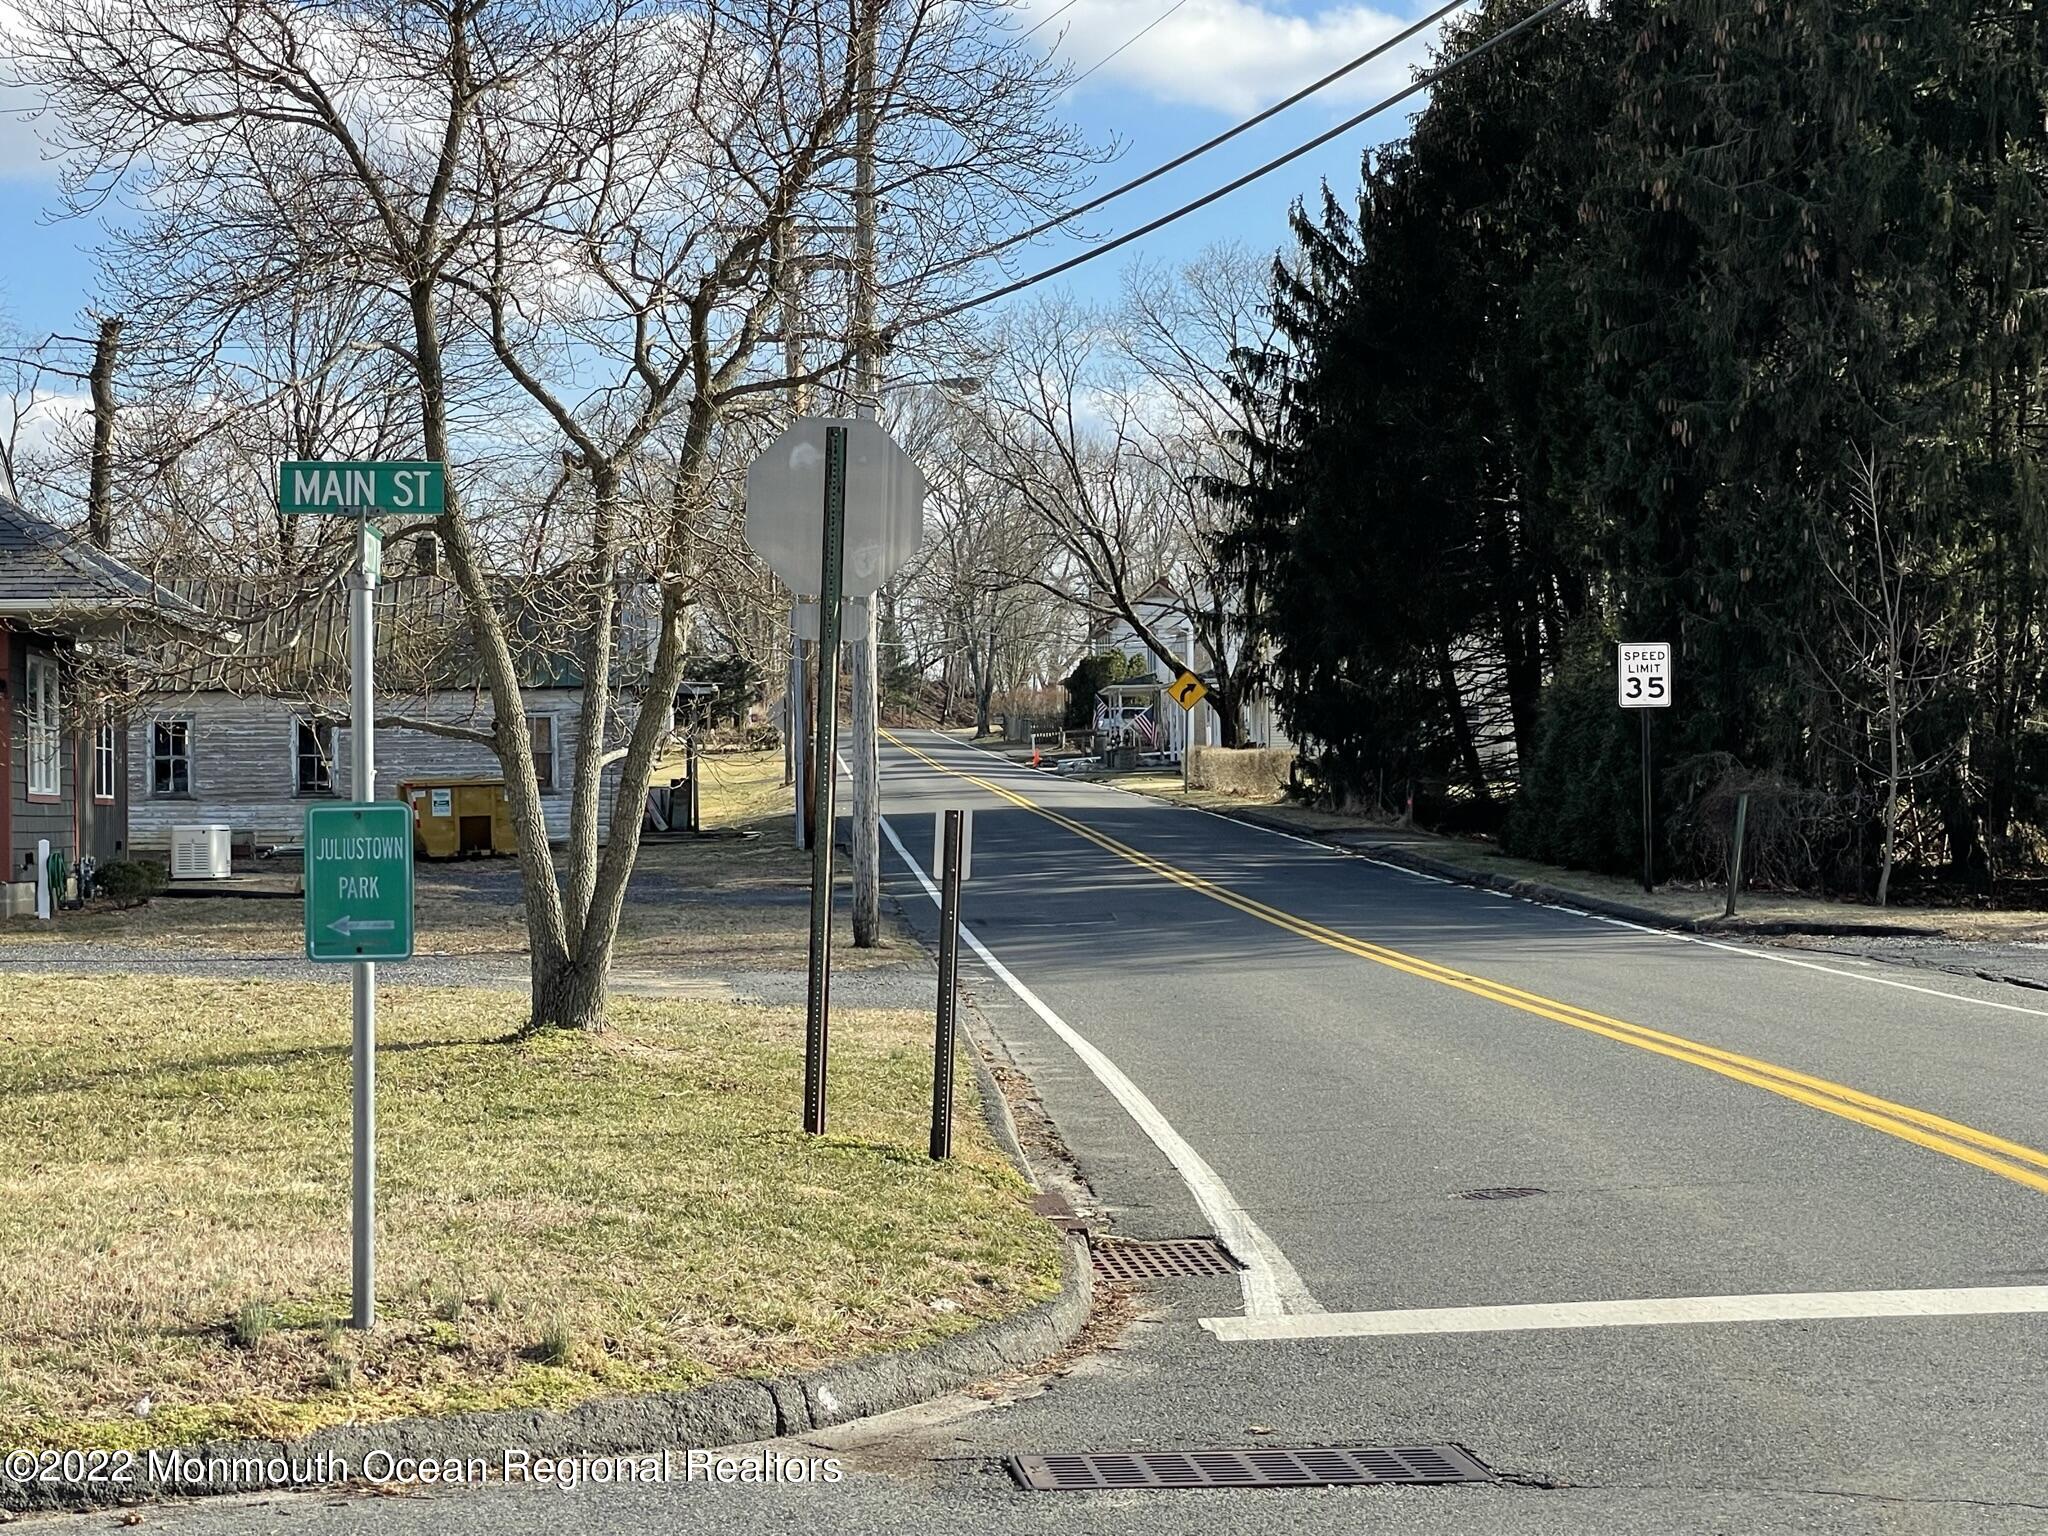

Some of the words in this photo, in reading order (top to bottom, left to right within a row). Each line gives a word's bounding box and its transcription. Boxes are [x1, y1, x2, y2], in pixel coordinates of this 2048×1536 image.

[295, 469, 376, 506] MAIN
[393, 470, 432, 507] ST
[1623, 651, 1665, 661] SPEED
[1628, 663, 1661, 673] LIMIT
[1625, 677, 1665, 698] 35
[316, 836, 404, 861] JULIUSTOWN
[339, 876, 380, 899] PARK
